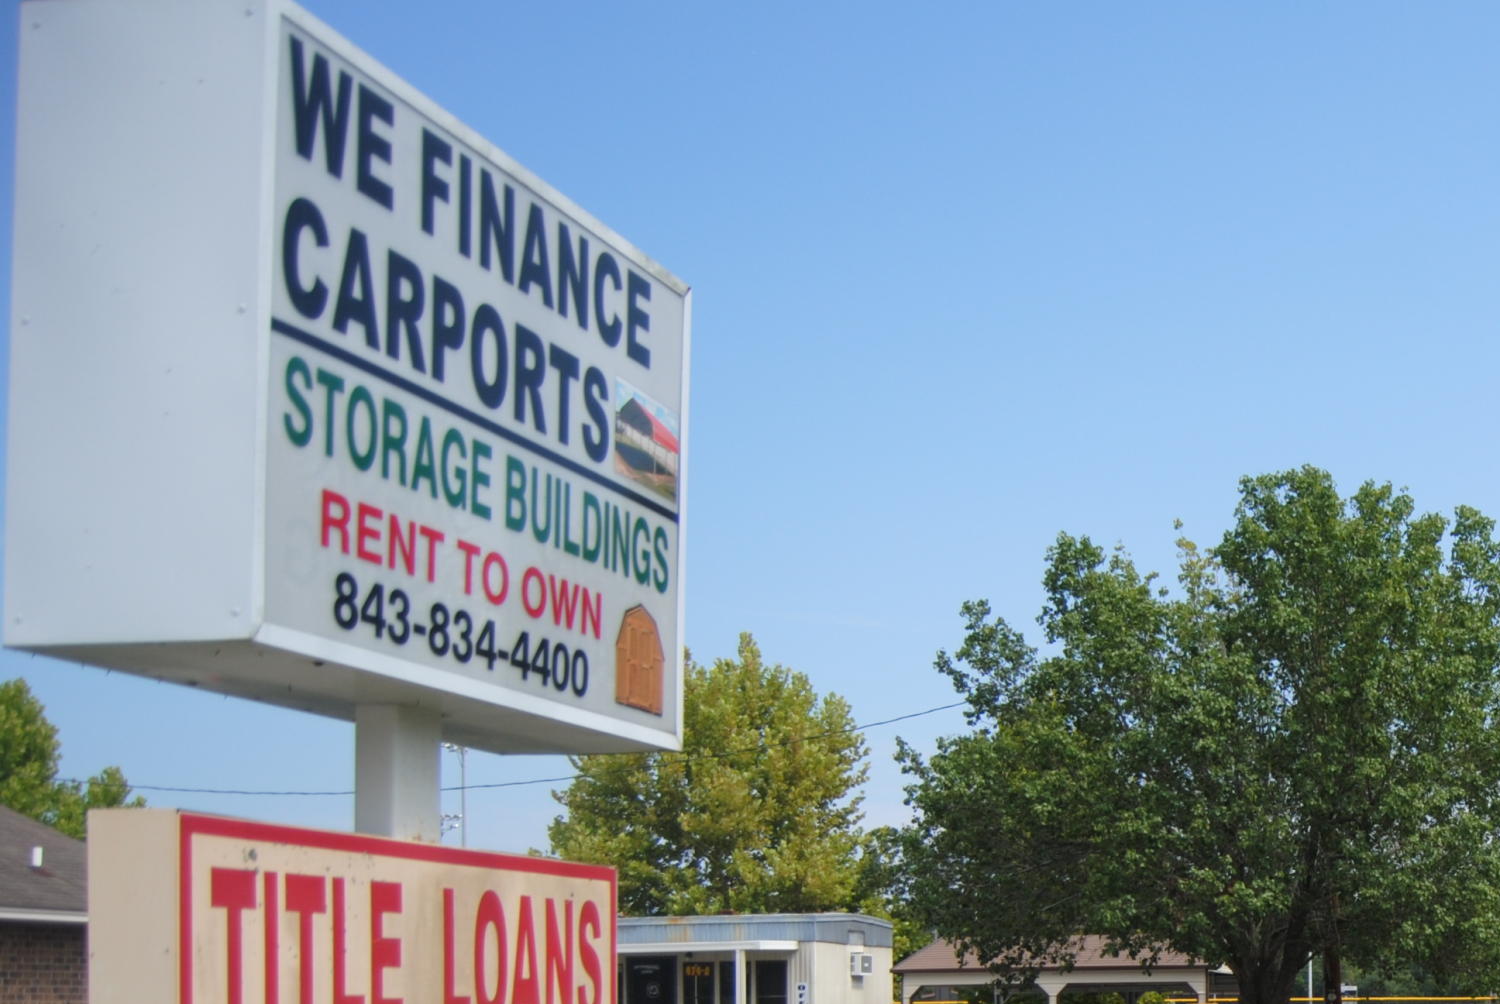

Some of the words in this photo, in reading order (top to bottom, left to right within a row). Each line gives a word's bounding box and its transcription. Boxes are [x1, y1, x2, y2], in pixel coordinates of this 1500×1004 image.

[289, 35, 395, 210] WE
[421, 127, 652, 370] FINANCE
[282, 197, 610, 463] CARPORTS
[282, 354, 493, 521] STORAGE
[504, 453, 670, 594] BUILDINGS
[320, 489, 445, 583] RENT
[457, 540, 509, 606] TO
[522, 566, 603, 641] OWN
[333, 571, 590, 698] 843-834-4400
